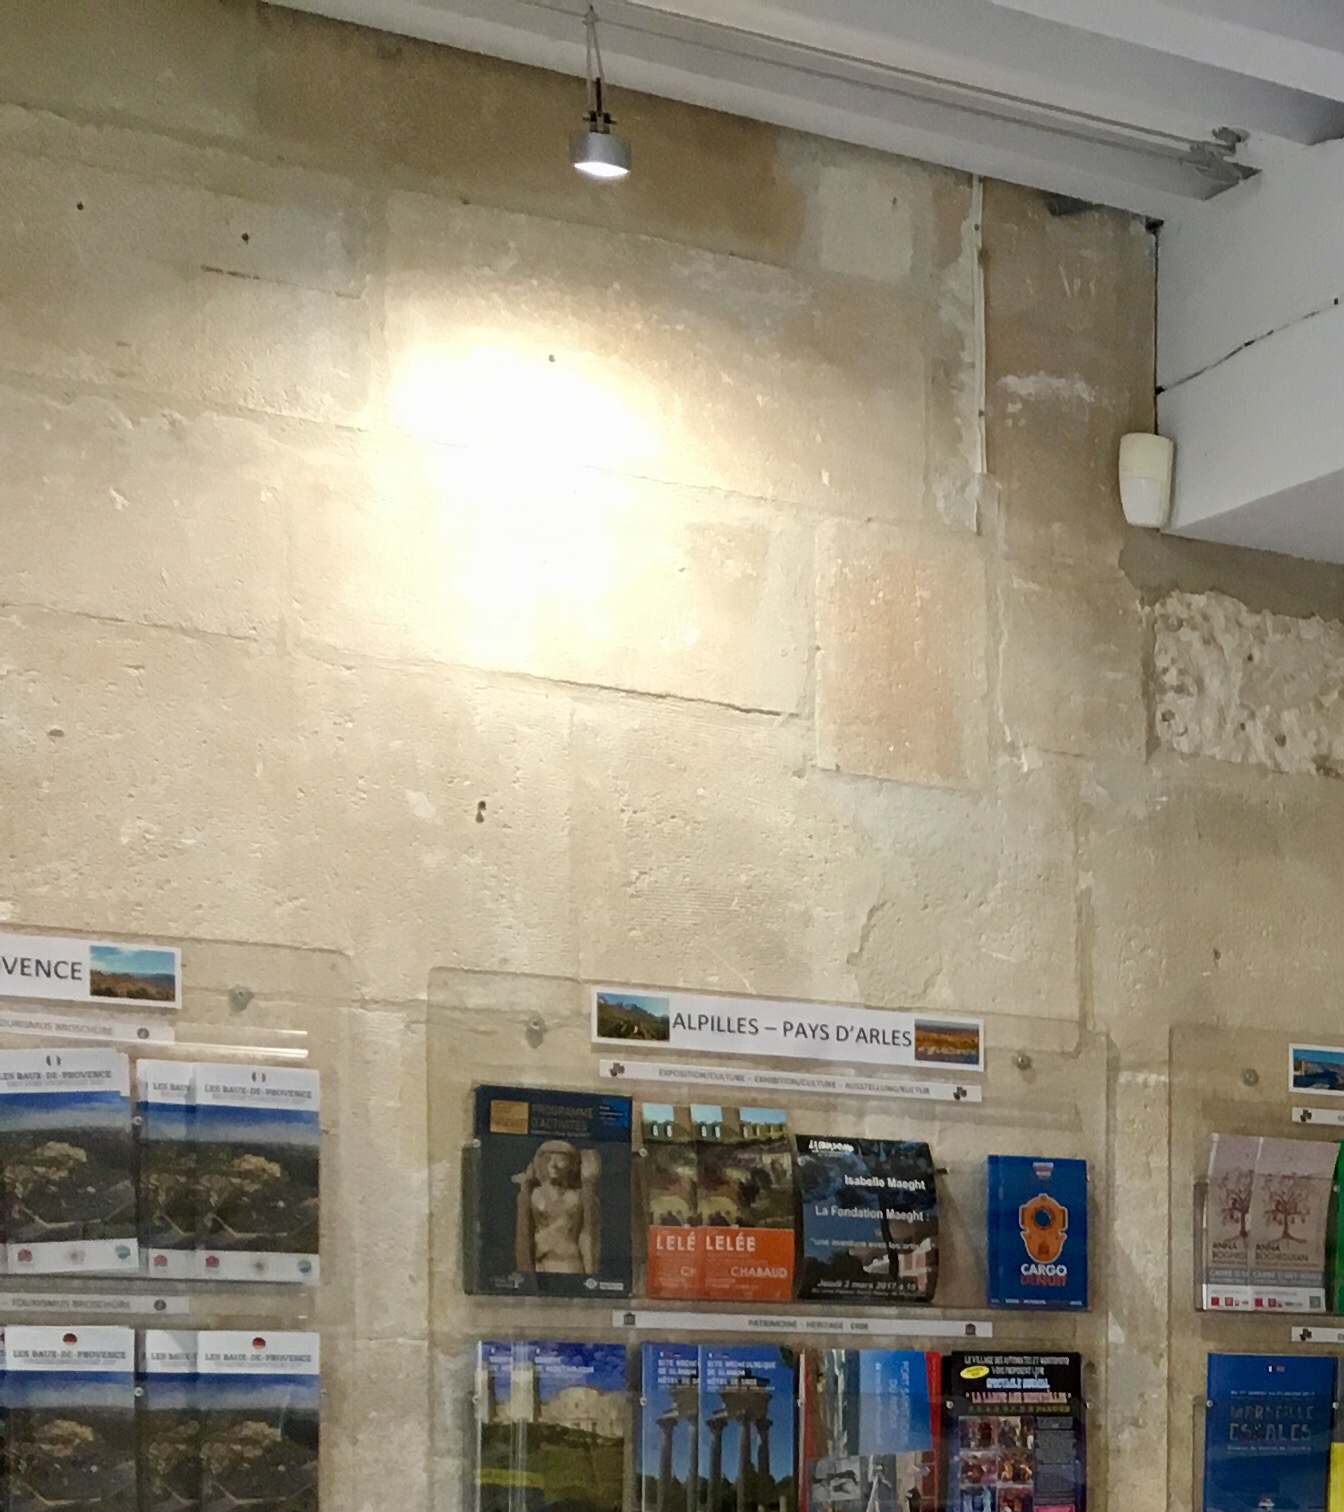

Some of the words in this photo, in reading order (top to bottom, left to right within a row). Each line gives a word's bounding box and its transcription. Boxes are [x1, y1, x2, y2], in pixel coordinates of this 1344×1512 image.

[672, 1013, 759, 1035] ALPILLES
[783, 1022, 829, 1041] PAYS
[836, 1026, 912, 1047] D'ARLES
[844, 1175, 885, 1187] Isabelle
[815, 1205, 828, 1216] La
[831, 1206, 883, 1219] Fondation
[706, 1232, 756, 1252] LELÉE
[731, 1266, 787, 1278] CHABAUD
[1021, 1263, 1067, 1276] CARGO
